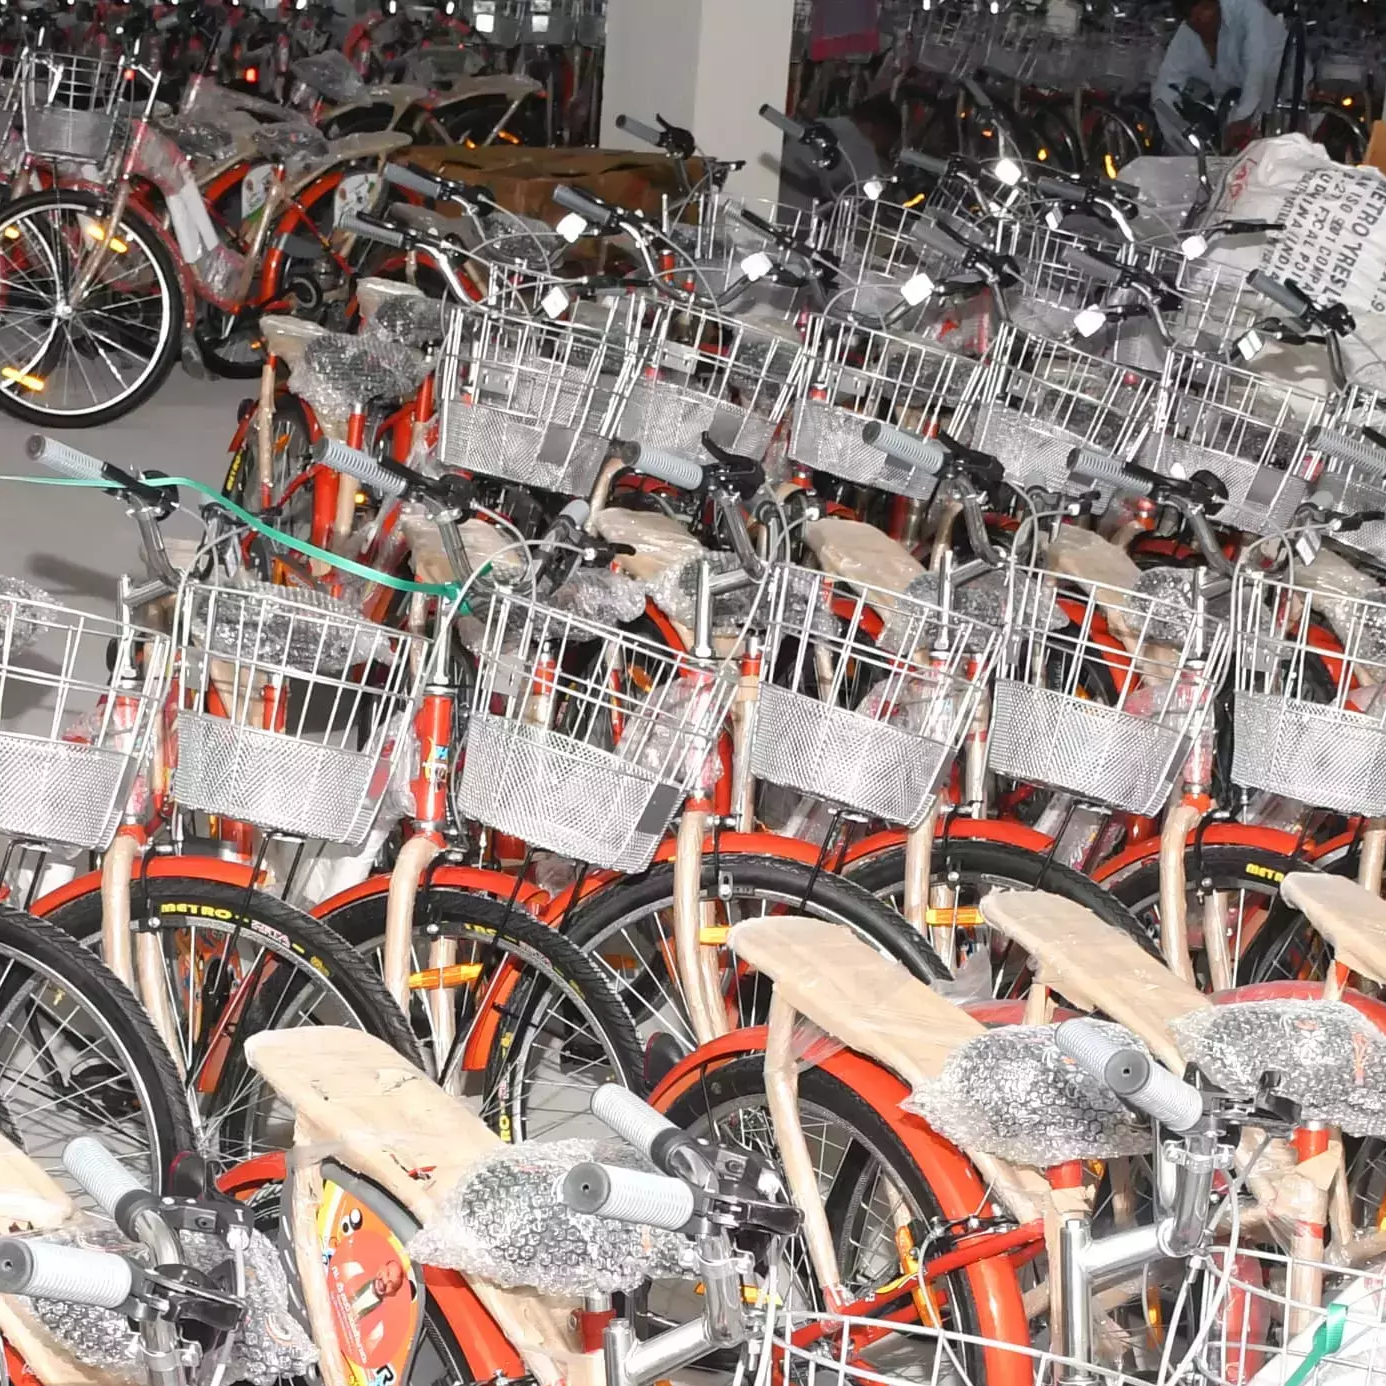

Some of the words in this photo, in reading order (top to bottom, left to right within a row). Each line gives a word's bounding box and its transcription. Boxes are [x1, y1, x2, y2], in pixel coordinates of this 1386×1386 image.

[1301, 245, 1332, 293] COMPA
[1245, 863, 1284, 882] METR
[161, 903, 233, 919] METRO
